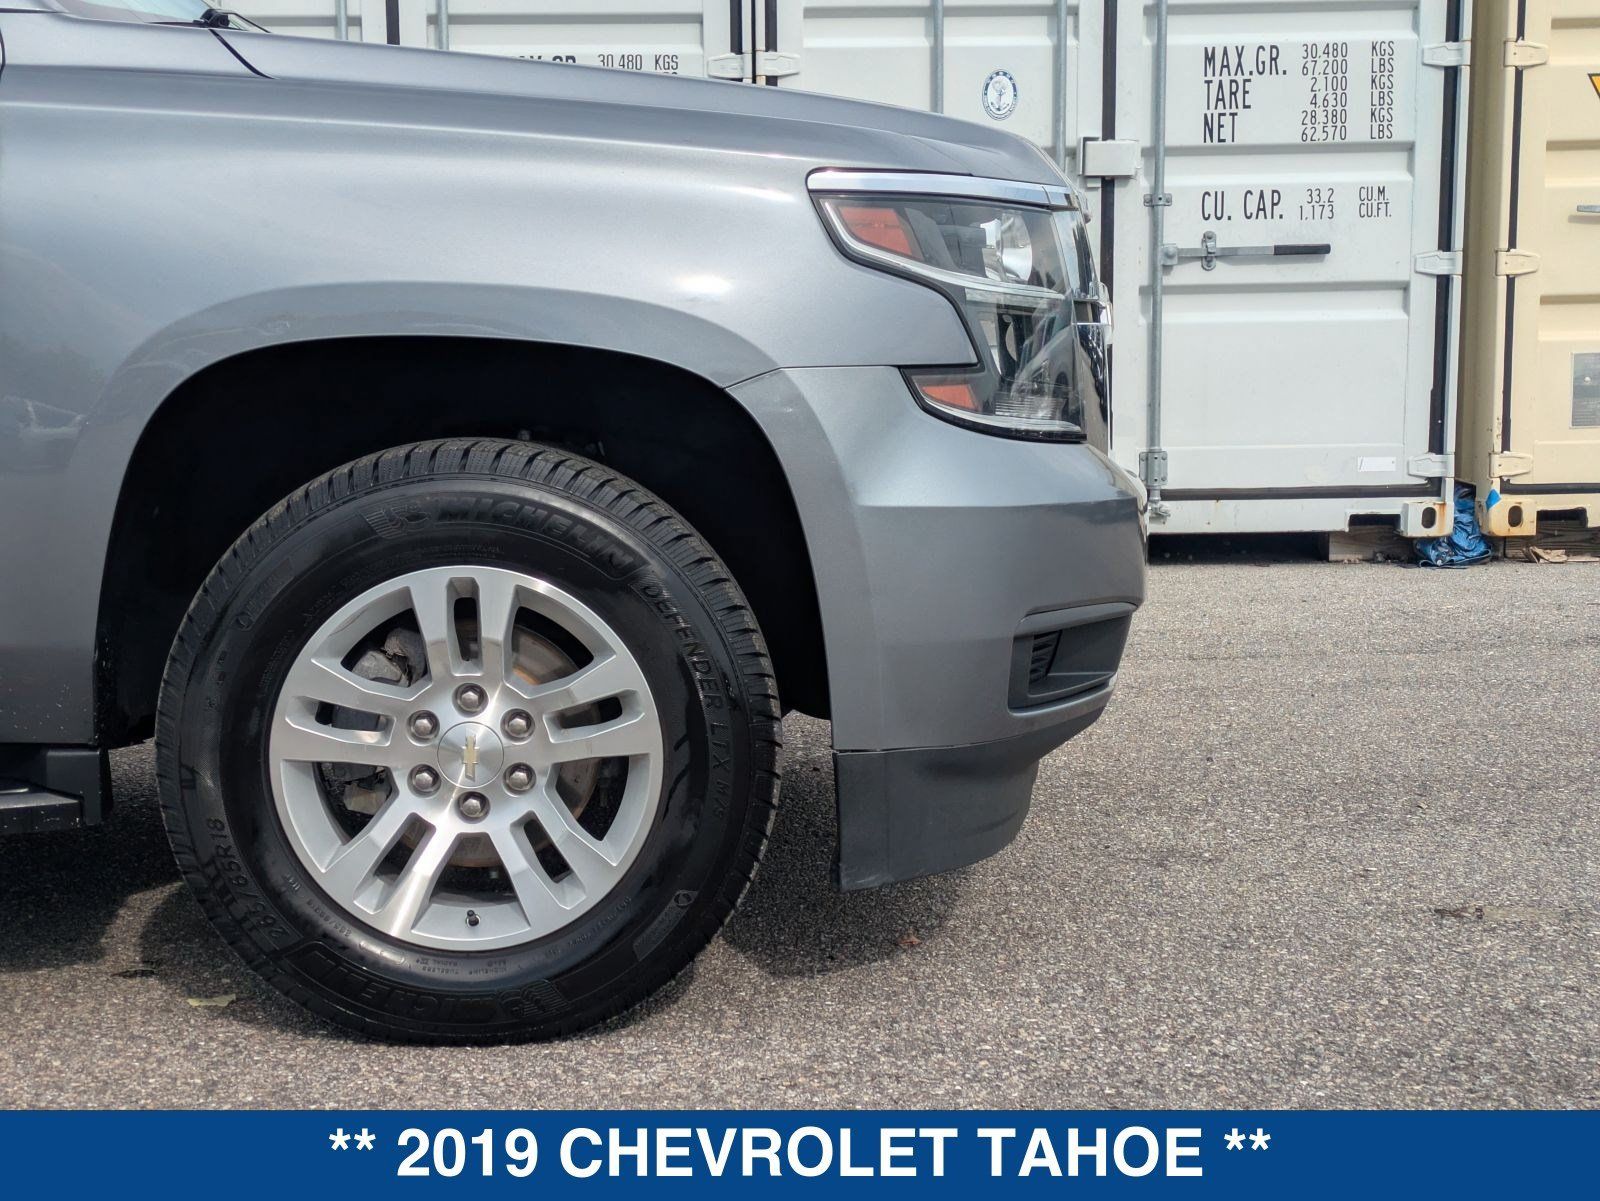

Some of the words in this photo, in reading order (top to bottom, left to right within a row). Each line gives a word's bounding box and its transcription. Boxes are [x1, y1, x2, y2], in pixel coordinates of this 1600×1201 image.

[598, 54, 642, 71] 30480
[654, 54, 679, 70] KGS
[1204, 44, 1288, 78] MAX.GR.
[1302, 42, 1348, 60] 30.480
[1371, 40, 1395, 57] KGS
[1302, 60, 1348, 76] 67.200
[1371, 58, 1394, 74] LBS
[1204, 78, 1252, 110] TARE
[1310, 76, 1348, 92] 2.100
[1370, 75, 1394, 90] KGS
[1310, 92, 1348, 108] 4.630
[1370, 91, 1394, 107] LBS
[1203, 112, 1238, 144] NET
[1301, 109, 1347, 126] 28.380
[1370, 108, 1393, 123] KGS
[1301, 126, 1347, 142] 62.570
[1370, 124, 1393, 140] LBS
[1202, 190, 1232, 221] CU.
[1243, 190, 1284, 220] CAP.
[1306, 188, 1334, 204] 33.2
[1358, 186, 1388, 202] CU.M.
[1300, 204, 1334, 220] 1.173
[1358, 202, 1392, 218] CU.FT.
[437, 494, 636, 572] MICHELIN
[642, 576, 725, 708] DEFENDER
